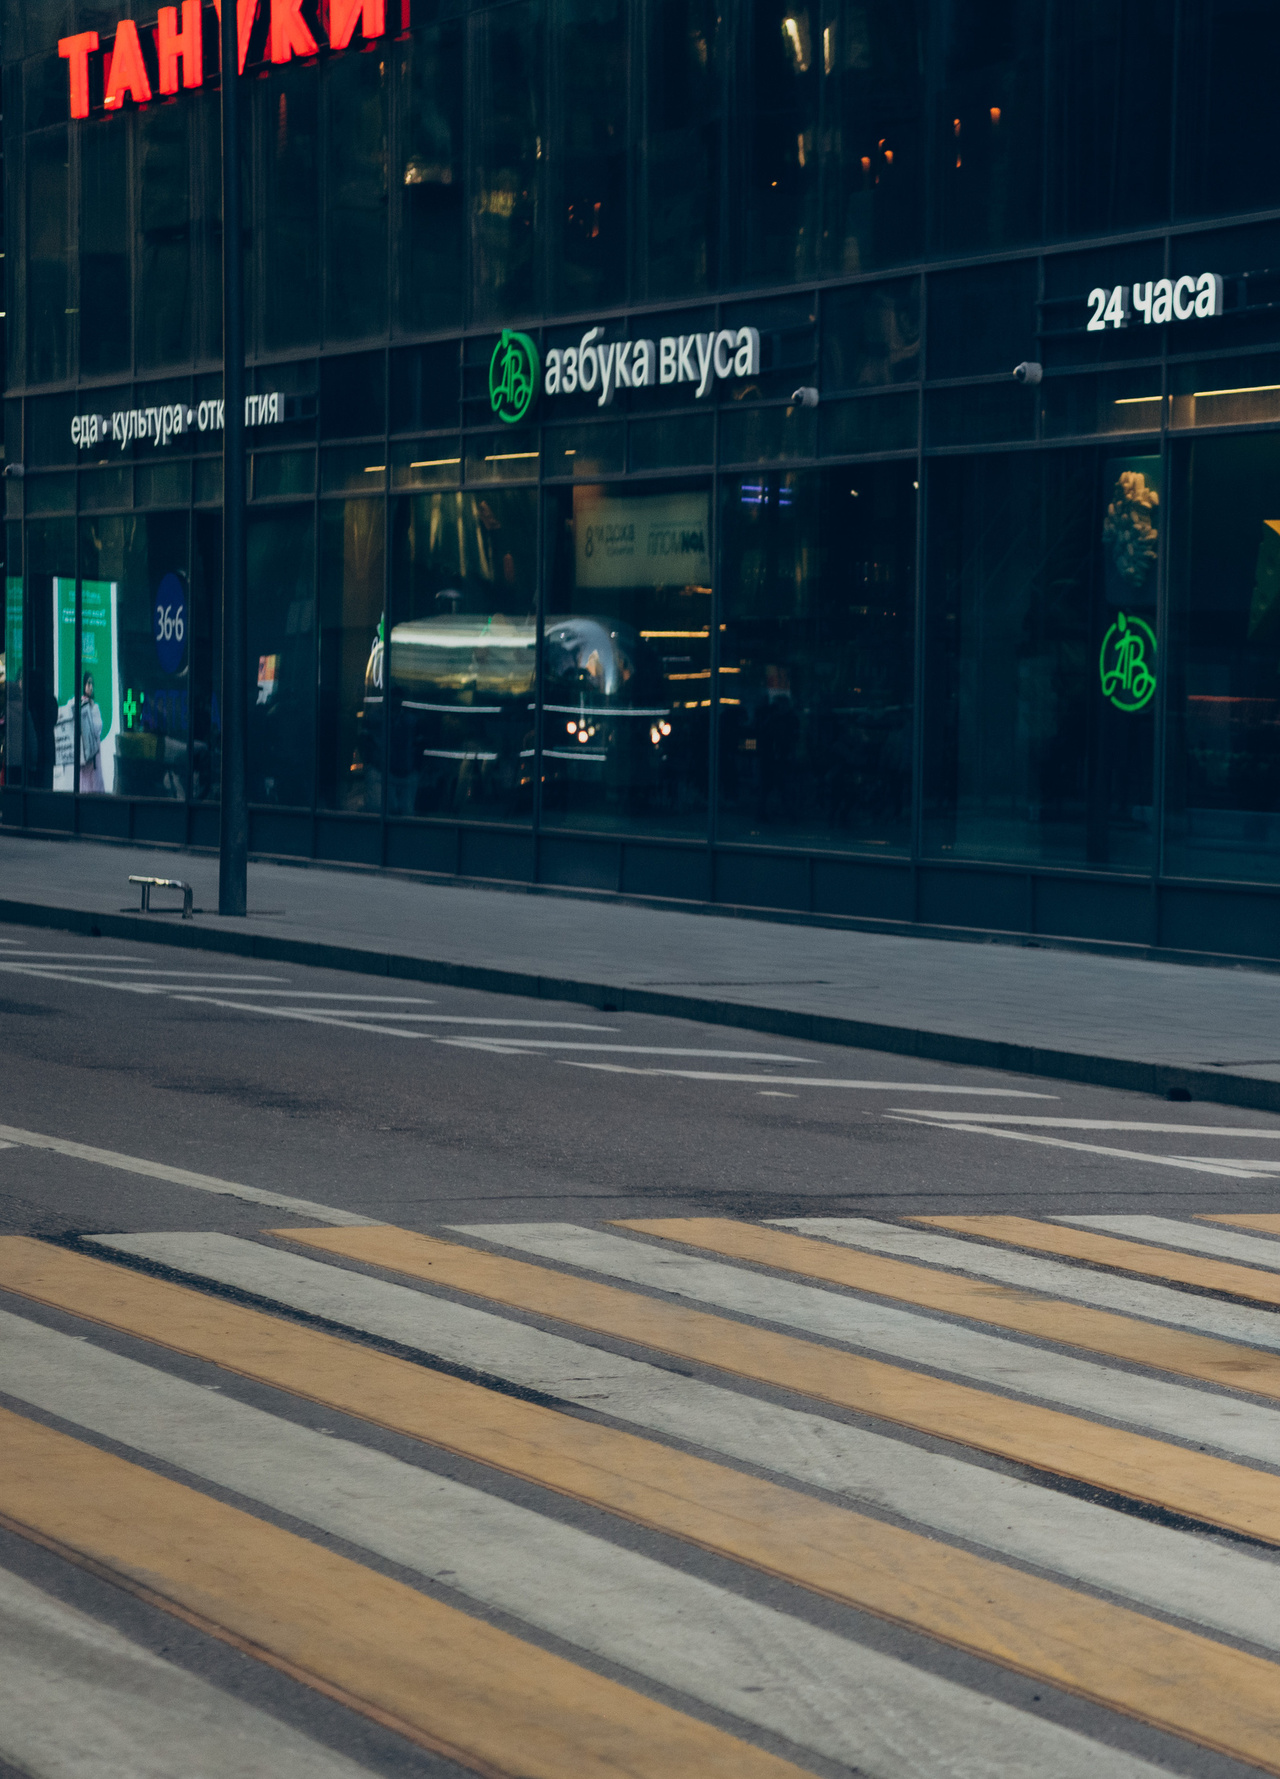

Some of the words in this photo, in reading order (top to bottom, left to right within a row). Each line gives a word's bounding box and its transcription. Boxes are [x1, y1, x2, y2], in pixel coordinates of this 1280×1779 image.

[1087, 288, 1125, 331] 24
[1133, 272, 1218, 325] часа
[545, 326, 651, 407] азбука
[659, 326, 759, 398] вкуса
[71, 414, 99, 449] еда
[112, 403, 183, 451] культура
[198, 392, 280, 432] отктия
[140, 688, 221, 732] АПТЕА
